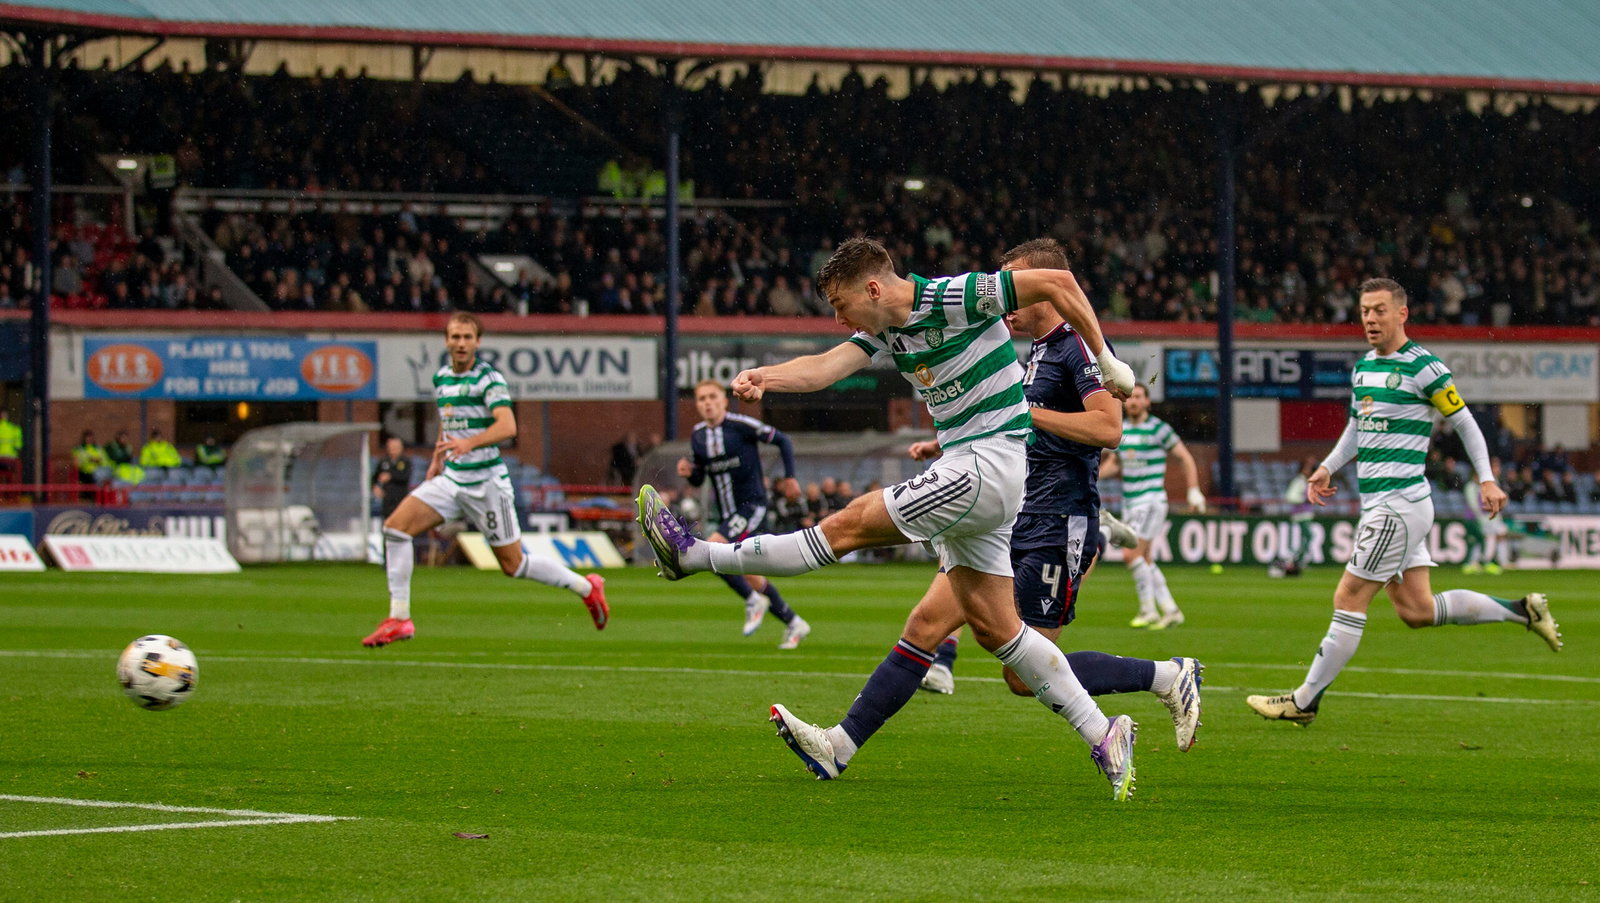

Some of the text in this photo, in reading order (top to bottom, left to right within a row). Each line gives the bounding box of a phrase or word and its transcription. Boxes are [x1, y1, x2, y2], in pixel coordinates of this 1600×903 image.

[168, 342, 294, 359] PLANT & TOOL
[208, 361, 249, 375] HIRE
[164, 378, 200, 394] FOR
[204, 378, 259, 394] EVERY
[263, 378, 299, 395] JOB
[922, 379, 965, 407] afabet
[1446, 390, 1460, 406] C
[486, 511, 497, 530] 8
[1180, 519, 1248, 562] OUT
[1253, 520, 1326, 563] OUR
[1042, 563, 1062, 598] 4
